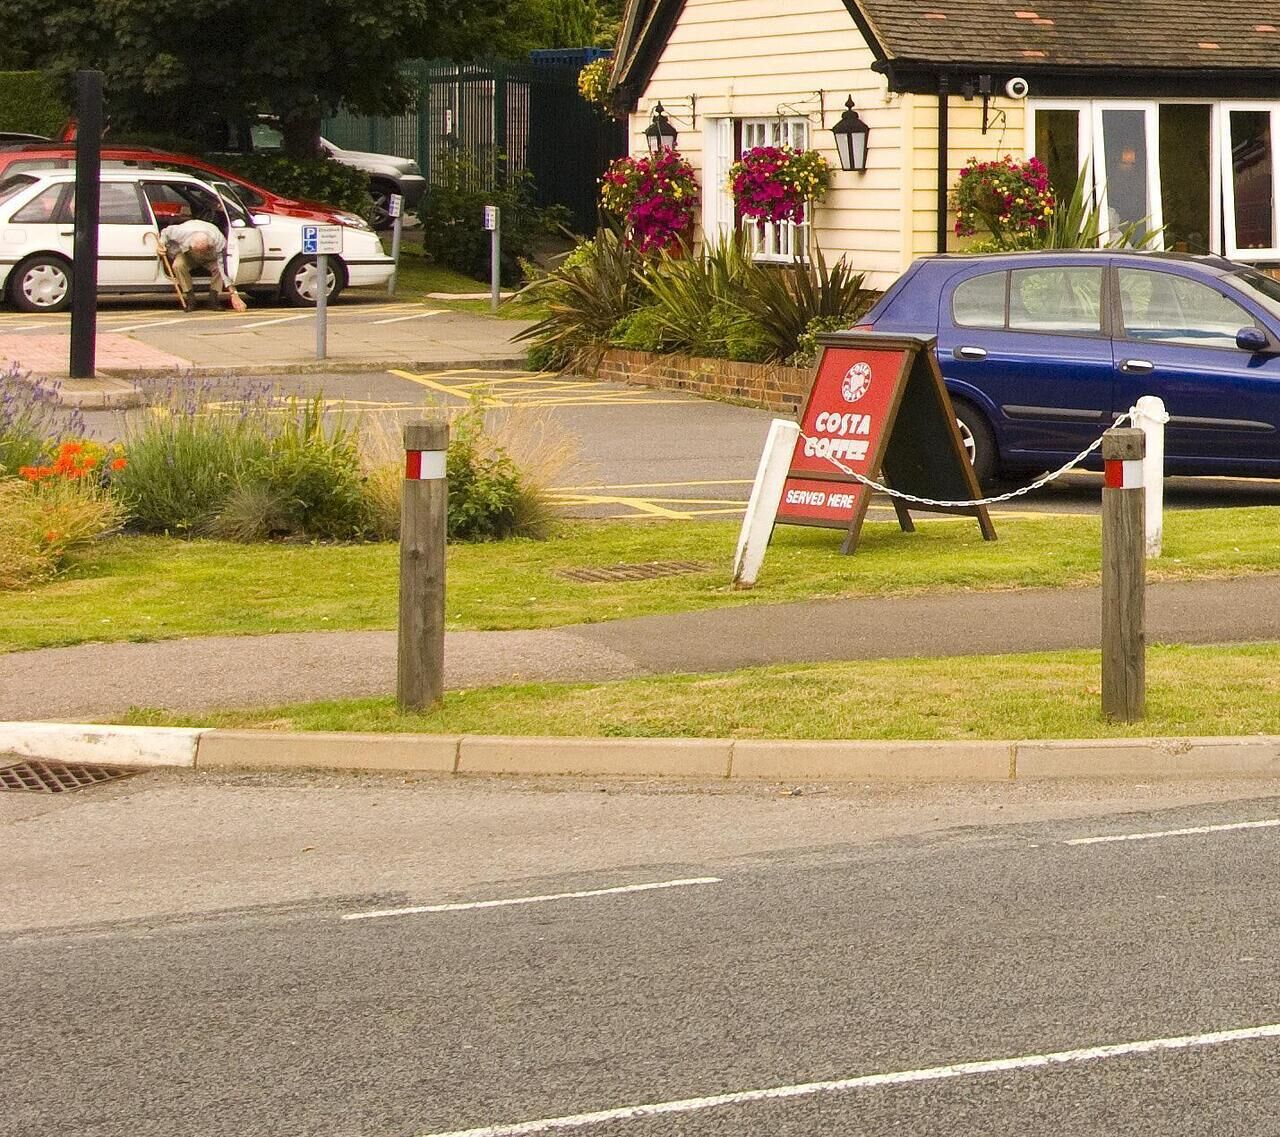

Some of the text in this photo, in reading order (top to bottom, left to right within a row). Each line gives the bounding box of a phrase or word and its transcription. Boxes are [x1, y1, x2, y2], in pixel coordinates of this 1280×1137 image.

[306, 228, 315, 239] P
[815, 411, 871, 436] COSTA
[804, 436, 870, 461] COFFEE
[785, 489, 855, 509] SERVED HERE
